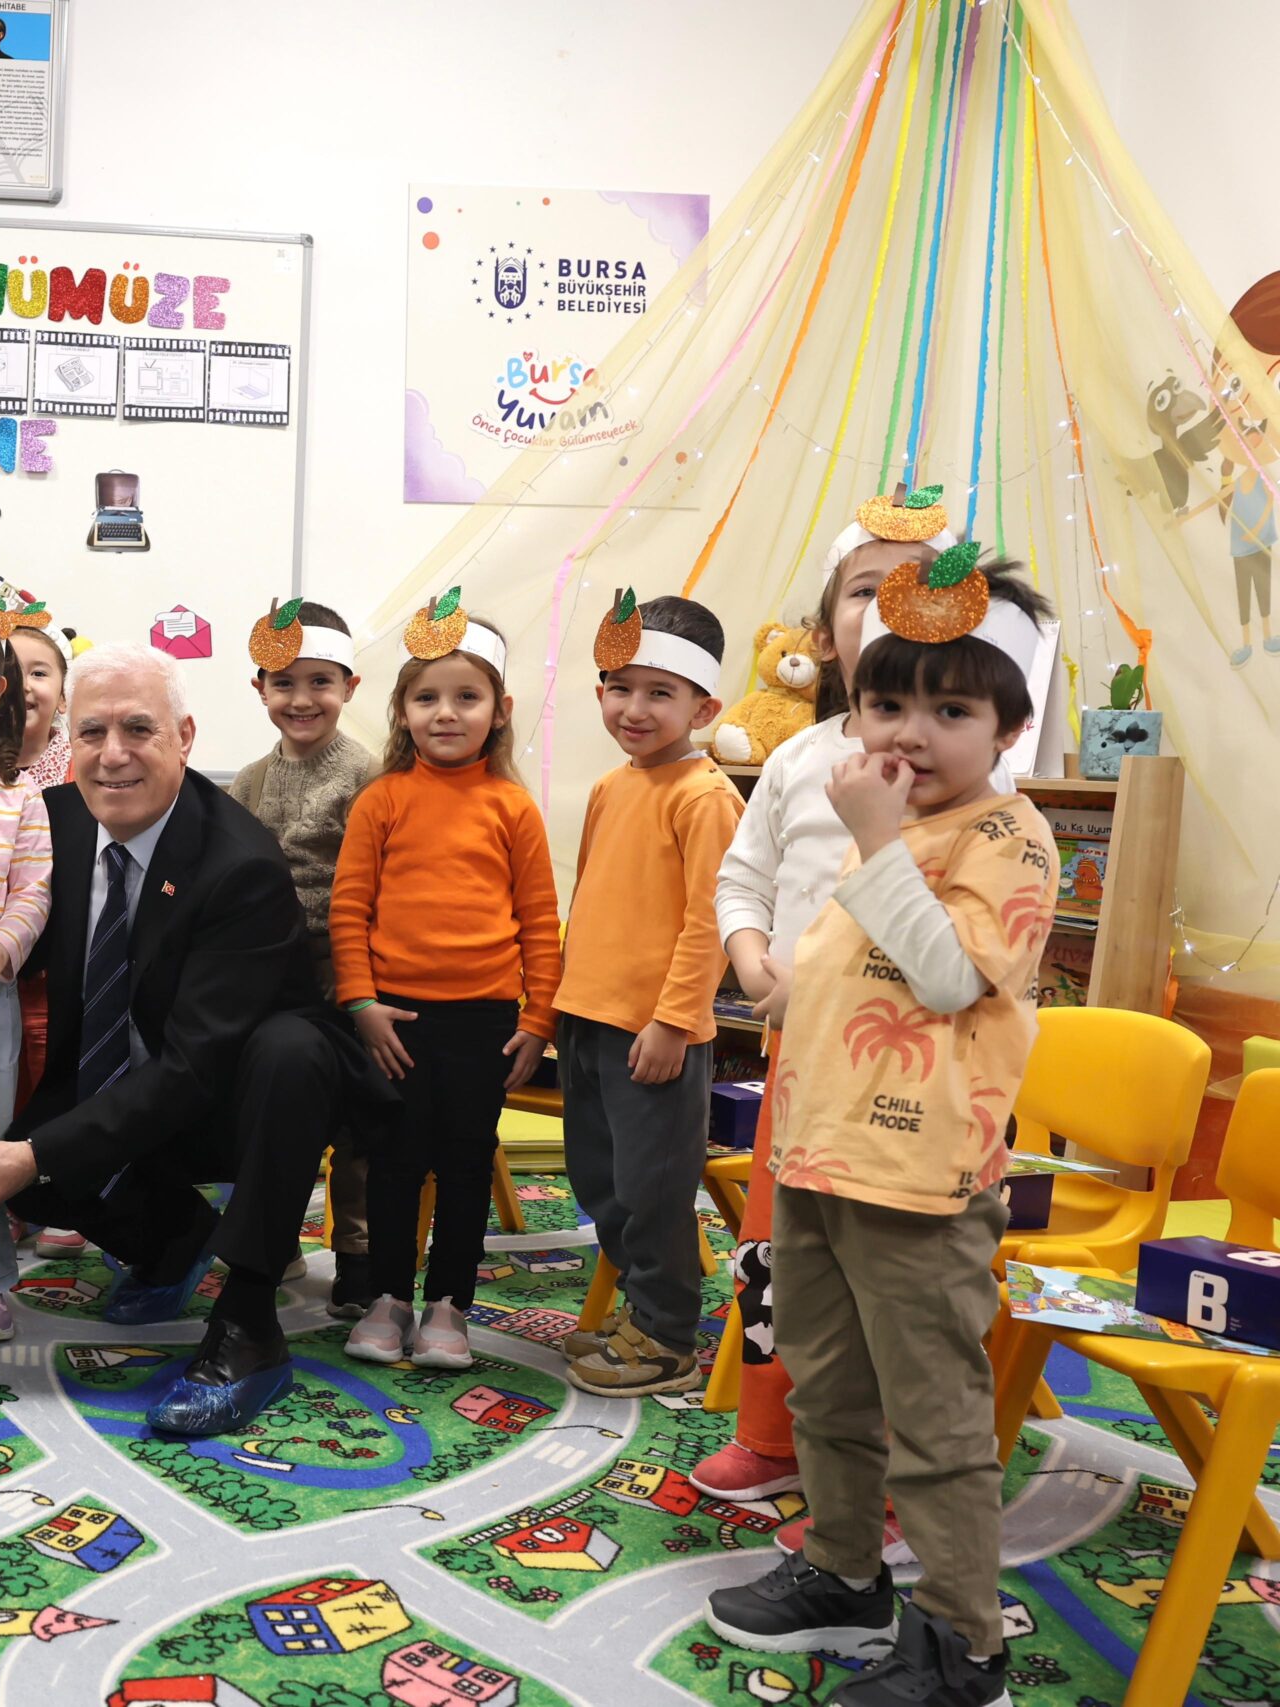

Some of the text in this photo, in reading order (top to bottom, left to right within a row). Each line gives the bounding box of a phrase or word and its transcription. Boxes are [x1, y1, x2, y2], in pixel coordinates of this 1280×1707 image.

[0, 1, 26, 11] HİTABE
[557, 258, 647, 280] BURSA
[557, 279, 647, 299] BÜYÜKŞEHİR
[557, 297, 647, 314] BELEDİYESİ
[507, 356, 600, 389] Bursa
[497, 389, 609, 433] Yuvam
[472, 413, 501, 436] Önce
[559, 419, 639, 448] Gülümseyecek
[1055, 822, 1067, 831] Bu
[1071, 823, 1084, 834] Kış
[863, 963, 908, 984] MOD
[873, 1094, 924, 1115] CHILL
[870, 1114, 921, 1133] MODE
[1186, 1270, 1229, 1334] B
